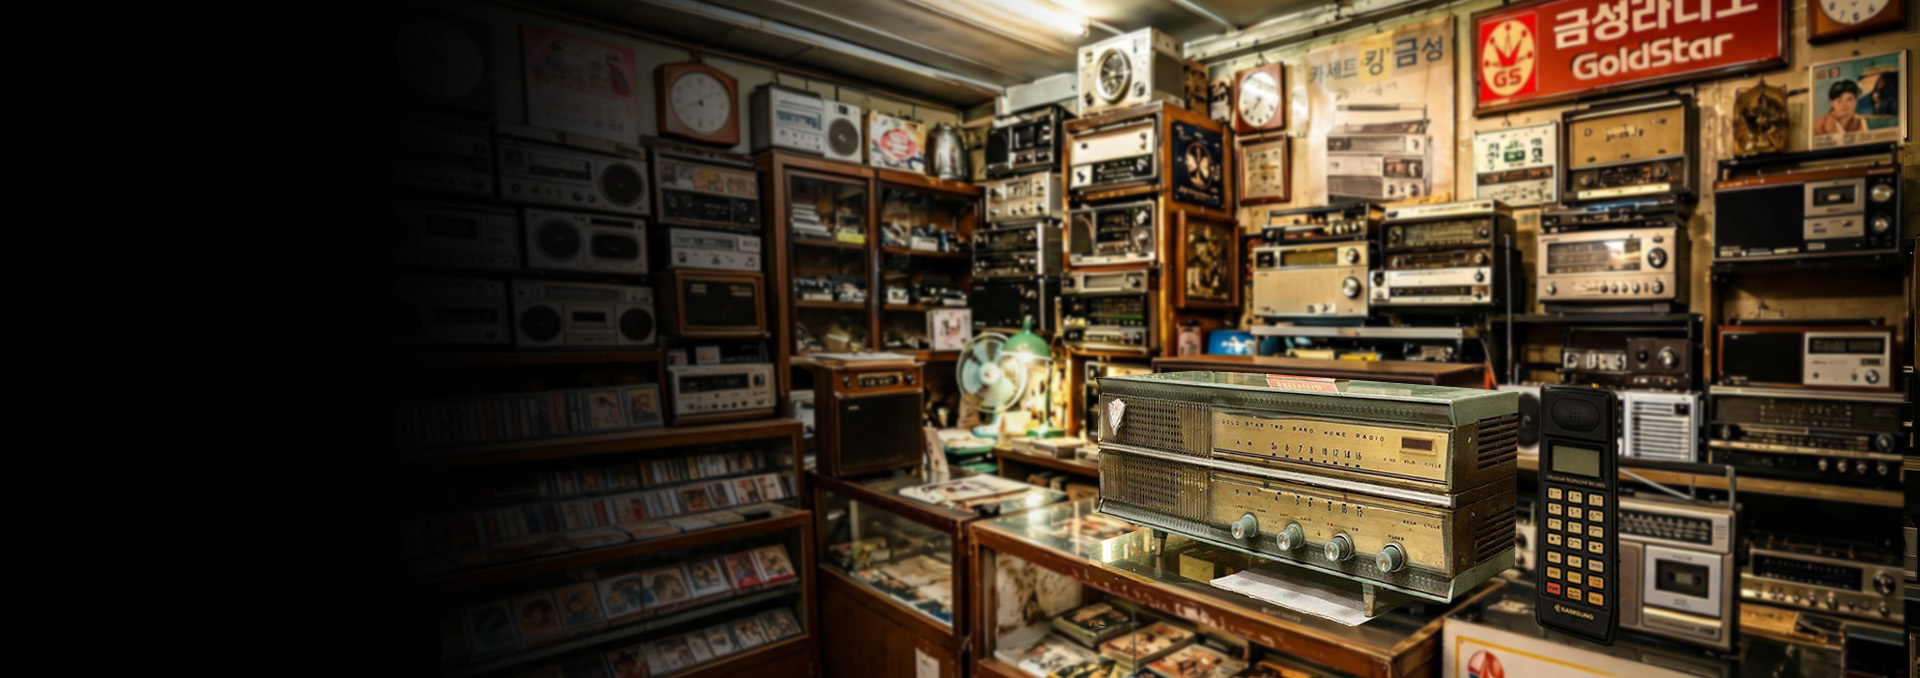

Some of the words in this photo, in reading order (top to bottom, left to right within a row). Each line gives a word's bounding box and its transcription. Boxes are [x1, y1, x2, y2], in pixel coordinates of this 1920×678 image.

[1308, 57, 1358, 84] 카세트
[1393, 35, 1445, 69] 금성
[1571, 33, 1735, 81] GoldStar
[1493, 67, 1522, 89] GS
[1355, 432, 1385, 442] RADIO
[1332, 448, 1339, 457] 12
[1561, 606, 1594, 620] SAMSUNG
